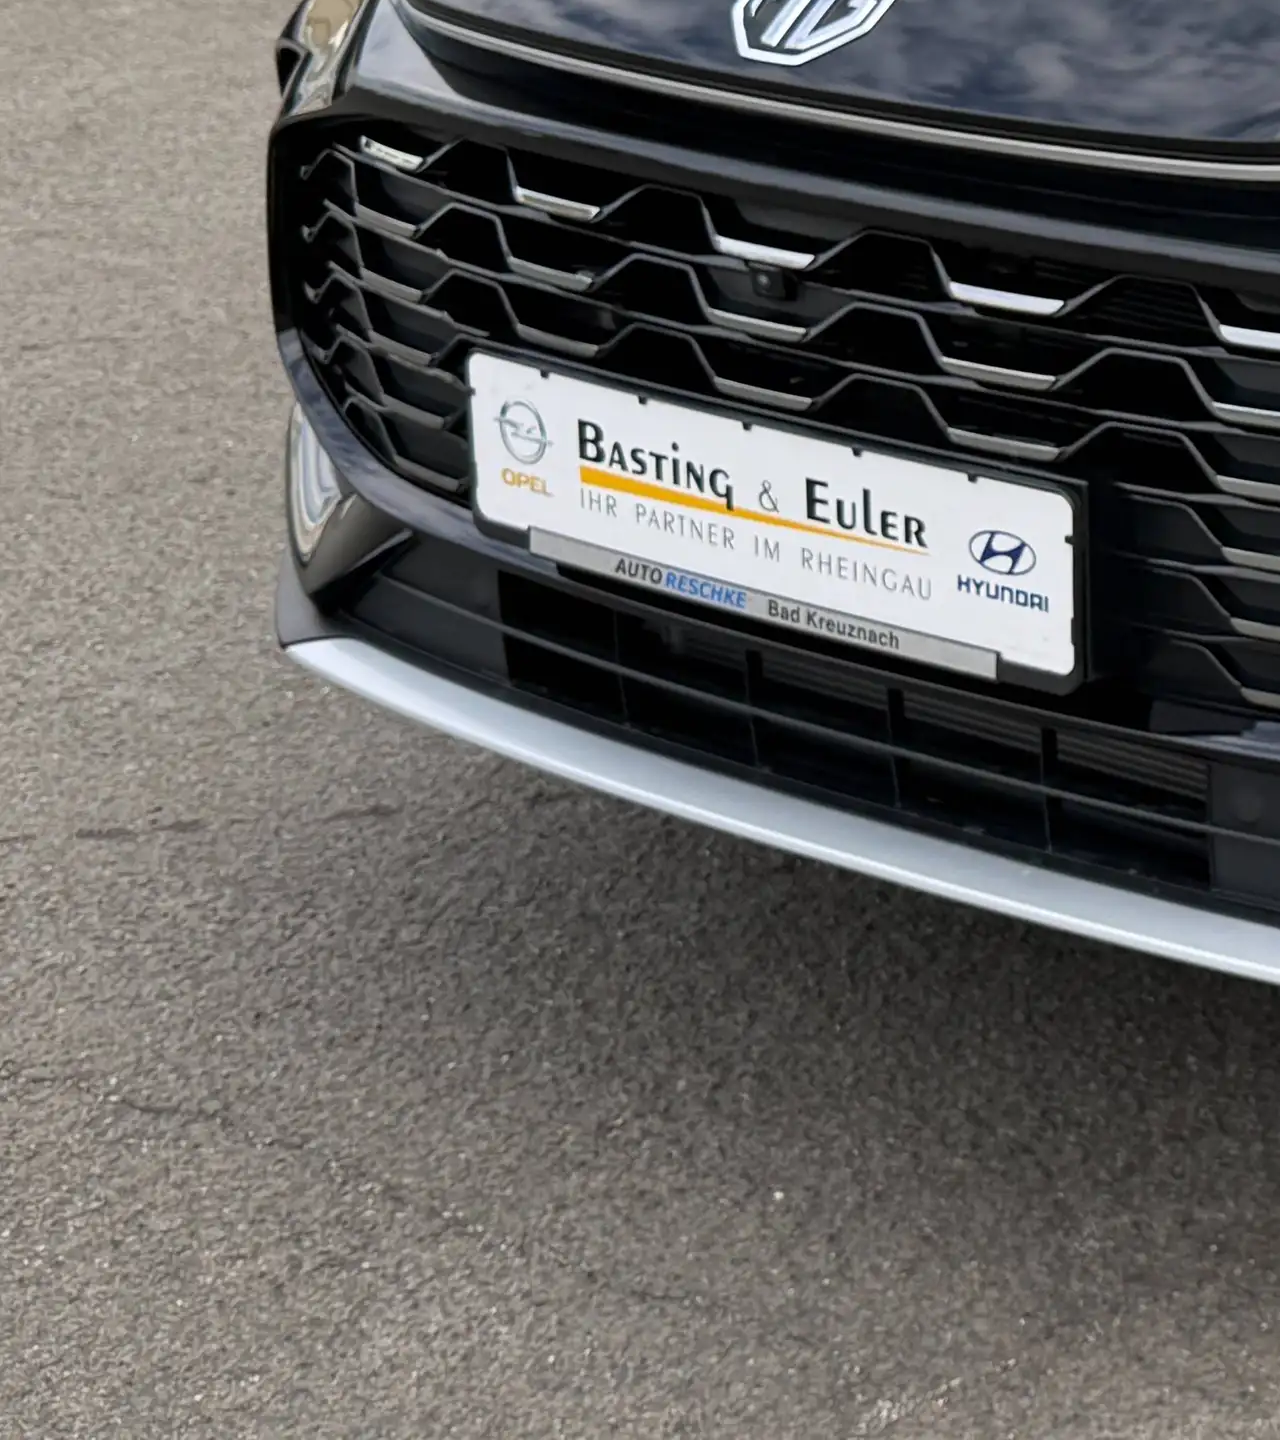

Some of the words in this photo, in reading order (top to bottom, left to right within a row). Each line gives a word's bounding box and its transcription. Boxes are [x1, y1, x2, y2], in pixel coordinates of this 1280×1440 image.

[501, 467, 554, 497] OPEL
[758, 479, 780, 513] &
[579, 487, 617, 517] IHR
[636, 503, 735, 550] PARTNER
[754, 535, 781, 563] IM
[801, 547, 932, 601] RHEINGAU
[957, 574, 1049, 613] HYUNDAI
[767, 599, 801, 624] Bad
[806, 610, 900, 650] Kreuznach
